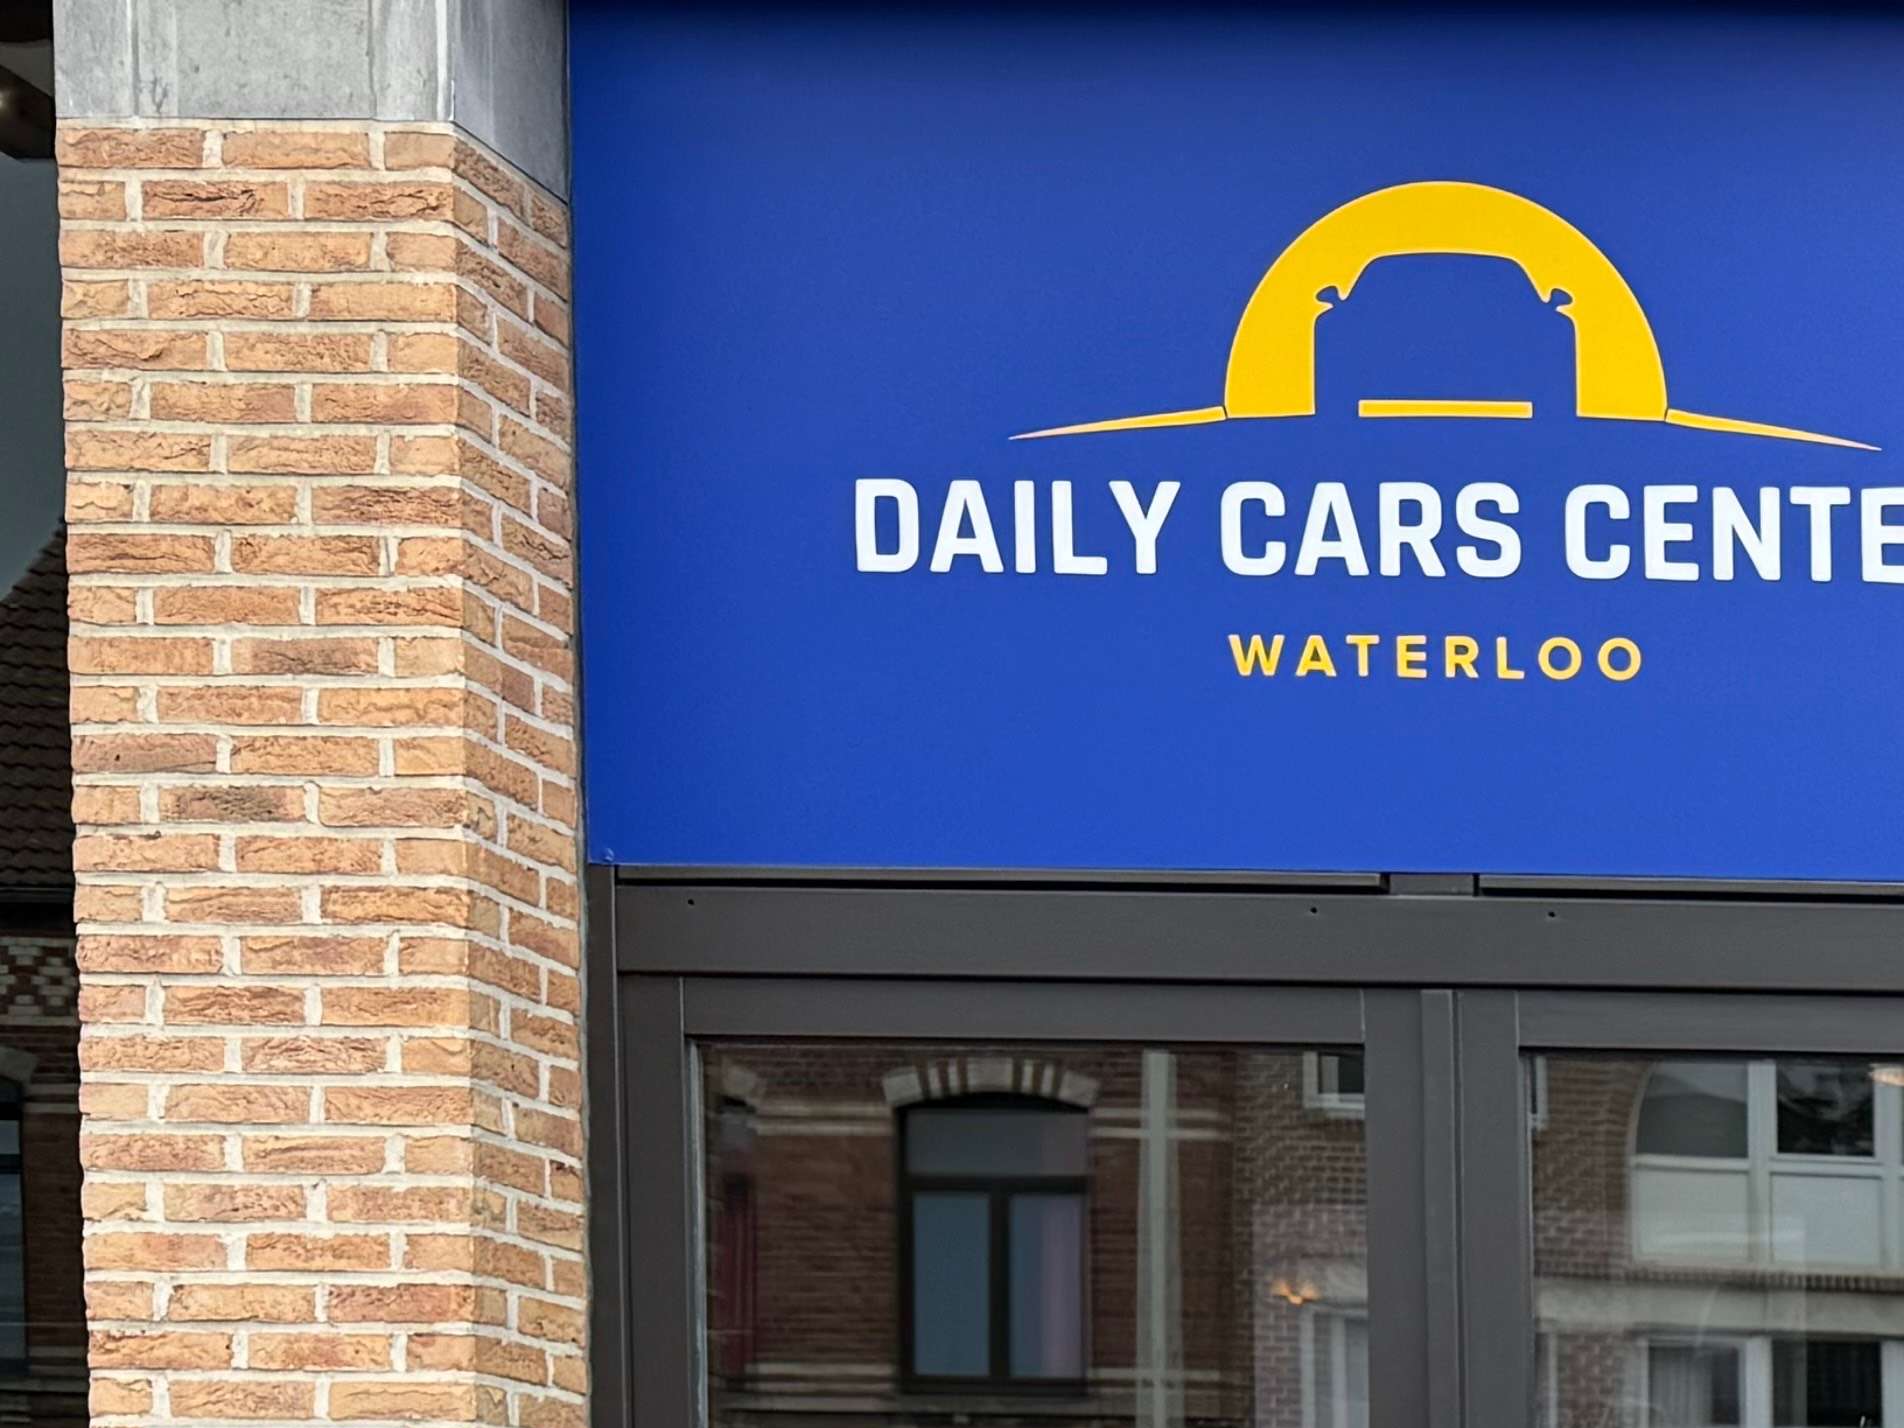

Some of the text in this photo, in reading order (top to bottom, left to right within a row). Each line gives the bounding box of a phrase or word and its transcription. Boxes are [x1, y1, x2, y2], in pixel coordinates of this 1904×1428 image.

[856, 479, 1180, 574] DAILY
[1221, 482, 1521, 577] CARS
[1229, 635, 1641, 680] WATERLOO
